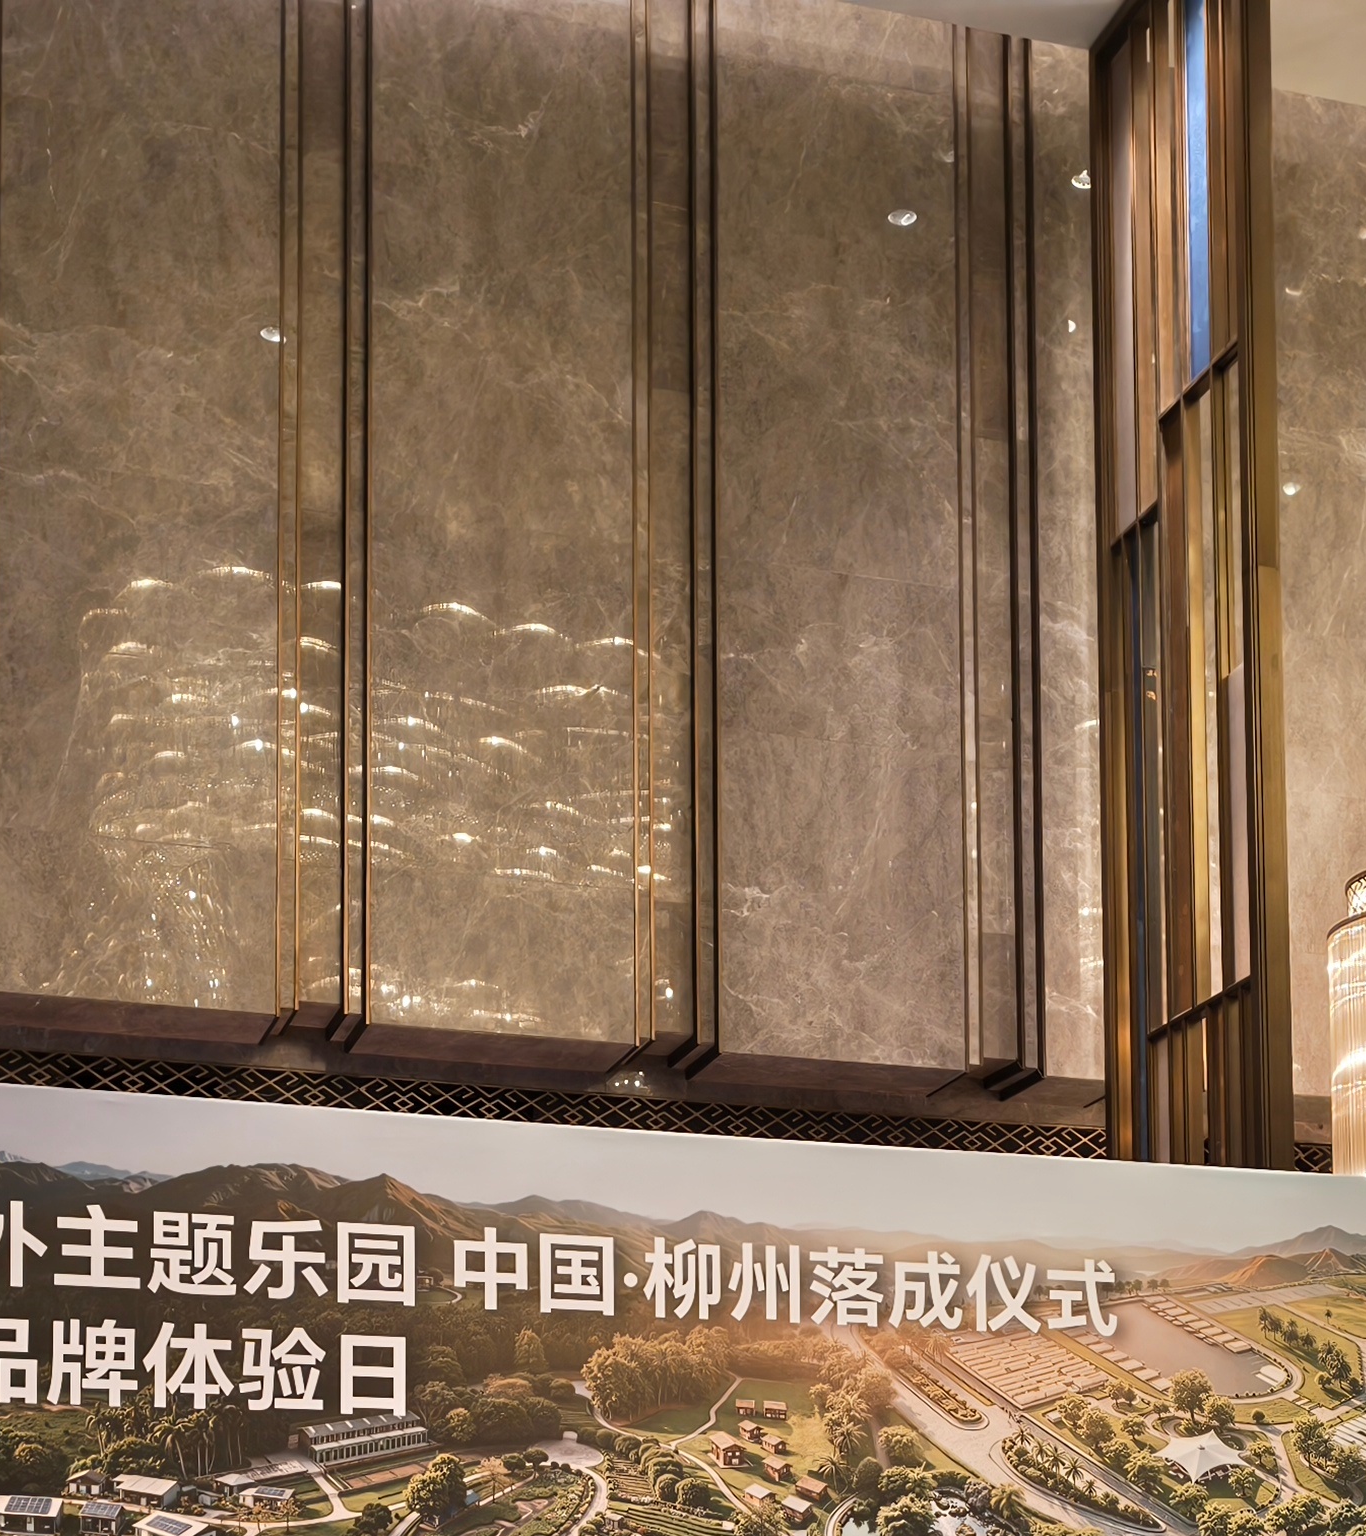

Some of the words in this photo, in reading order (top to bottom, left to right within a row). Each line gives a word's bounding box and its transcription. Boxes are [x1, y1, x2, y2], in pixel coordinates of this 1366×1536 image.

[452, 1226, 1118, 1337] 中国·柳州落成仪式
